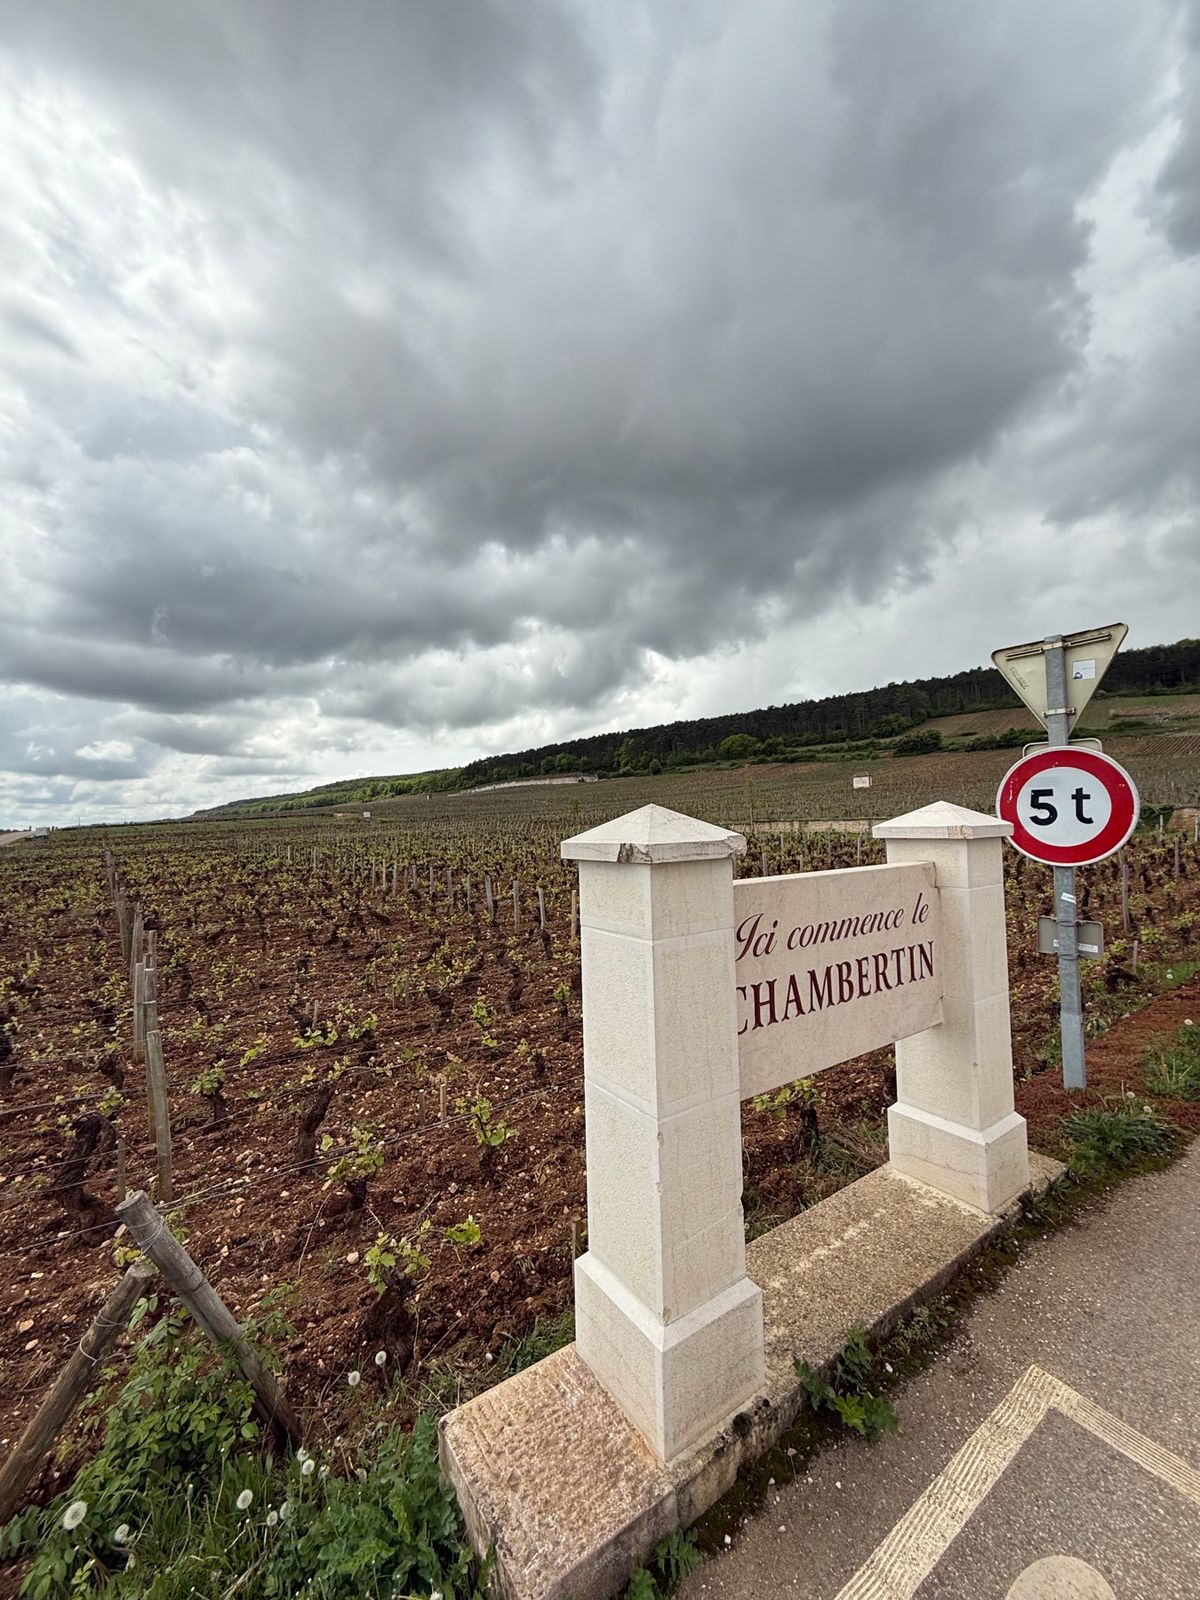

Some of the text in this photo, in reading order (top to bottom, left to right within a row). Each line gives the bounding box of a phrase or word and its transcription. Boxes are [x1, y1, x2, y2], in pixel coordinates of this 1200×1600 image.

[1029, 787, 1094, 826] 5 t
[735, 892, 929, 962] Ici commence le
